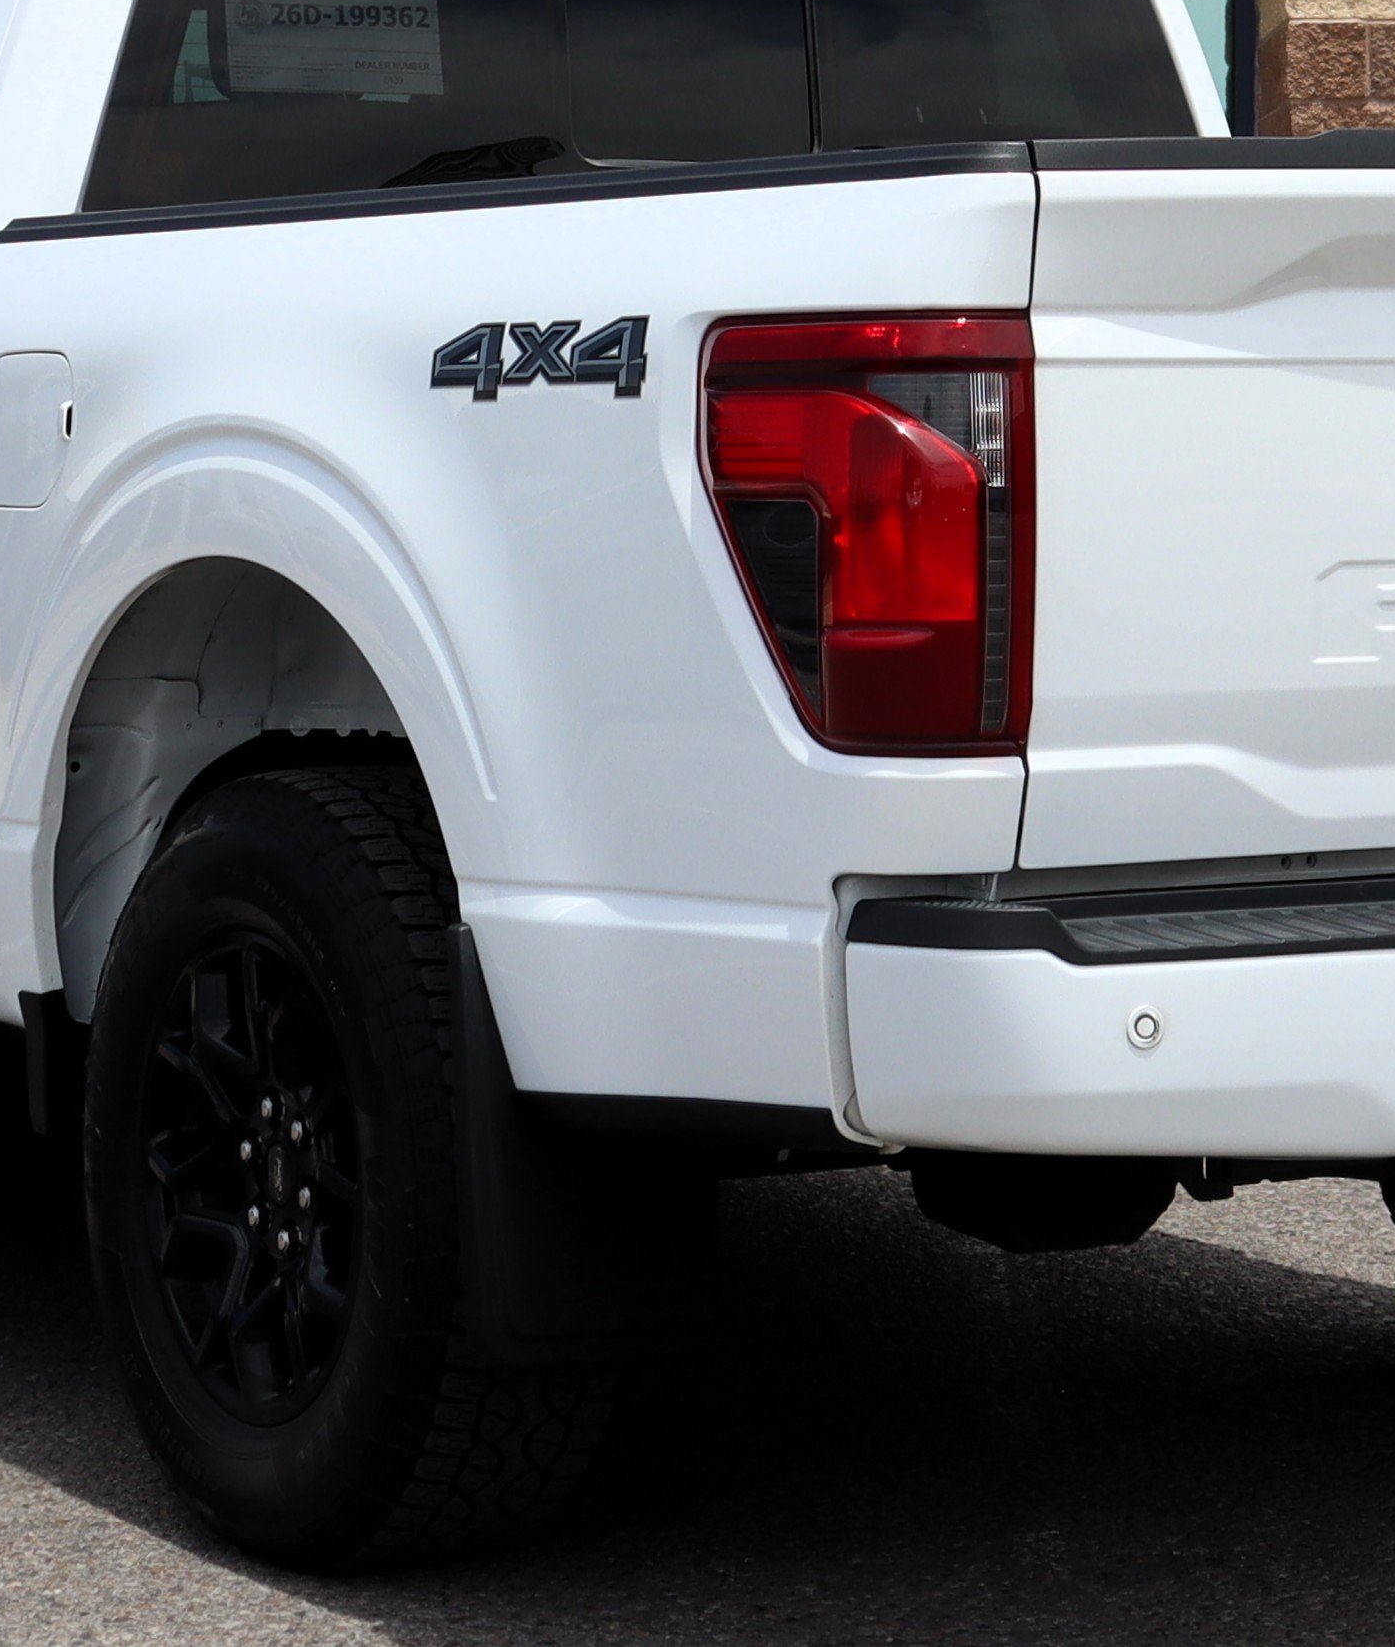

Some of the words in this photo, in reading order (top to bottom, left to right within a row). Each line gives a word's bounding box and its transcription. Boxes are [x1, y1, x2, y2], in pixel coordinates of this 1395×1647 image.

[270, 3, 431, 29] 26D-199362
[354, 59, 391, 70] DEALER
[392, 61, 431, 71] NUMBER
